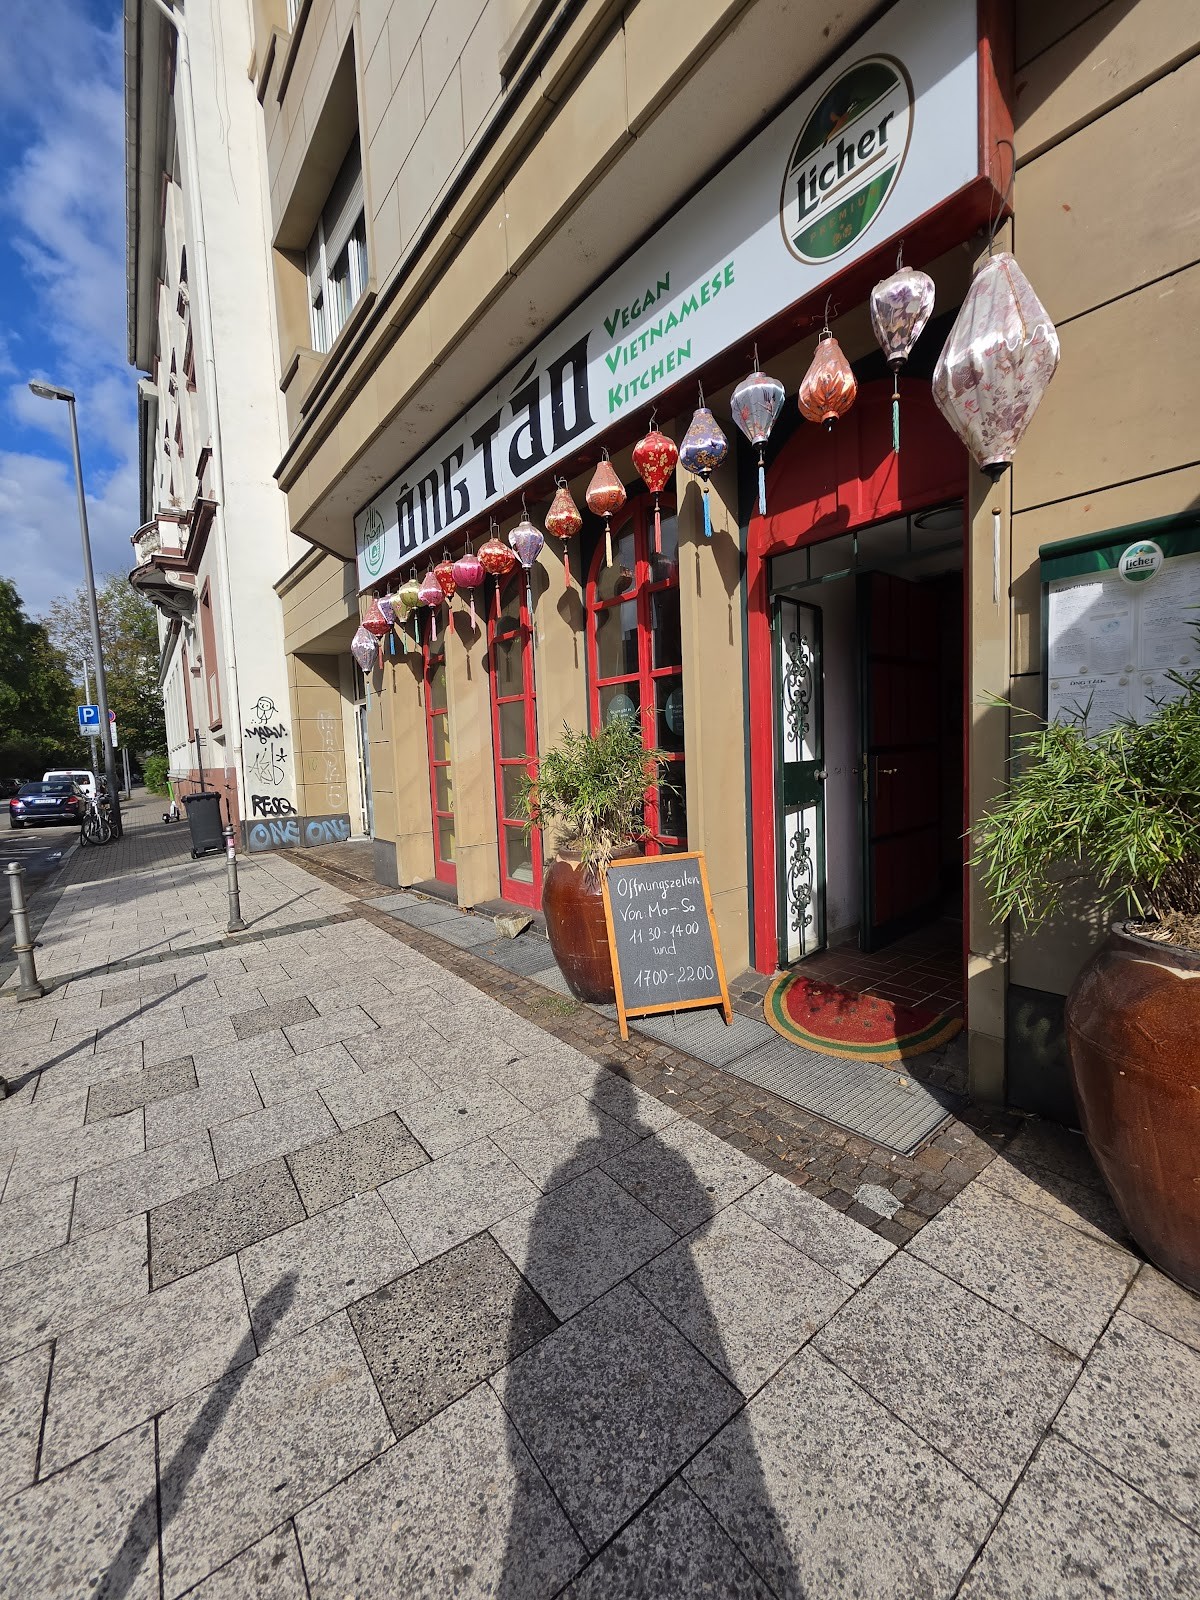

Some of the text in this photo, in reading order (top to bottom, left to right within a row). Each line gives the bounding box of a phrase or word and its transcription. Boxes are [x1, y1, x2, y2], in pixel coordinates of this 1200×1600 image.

[797, 111, 894, 223] Licher
[603, 271, 670, 338] VEGAN
[605, 261, 735, 375] VIETNAMESE
[608, 338, 691, 414] KITCHEN
[1126, 556, 1155, 570] Licher
[83, 708, 95, 723] P
[652, 939, 677, 954] und
